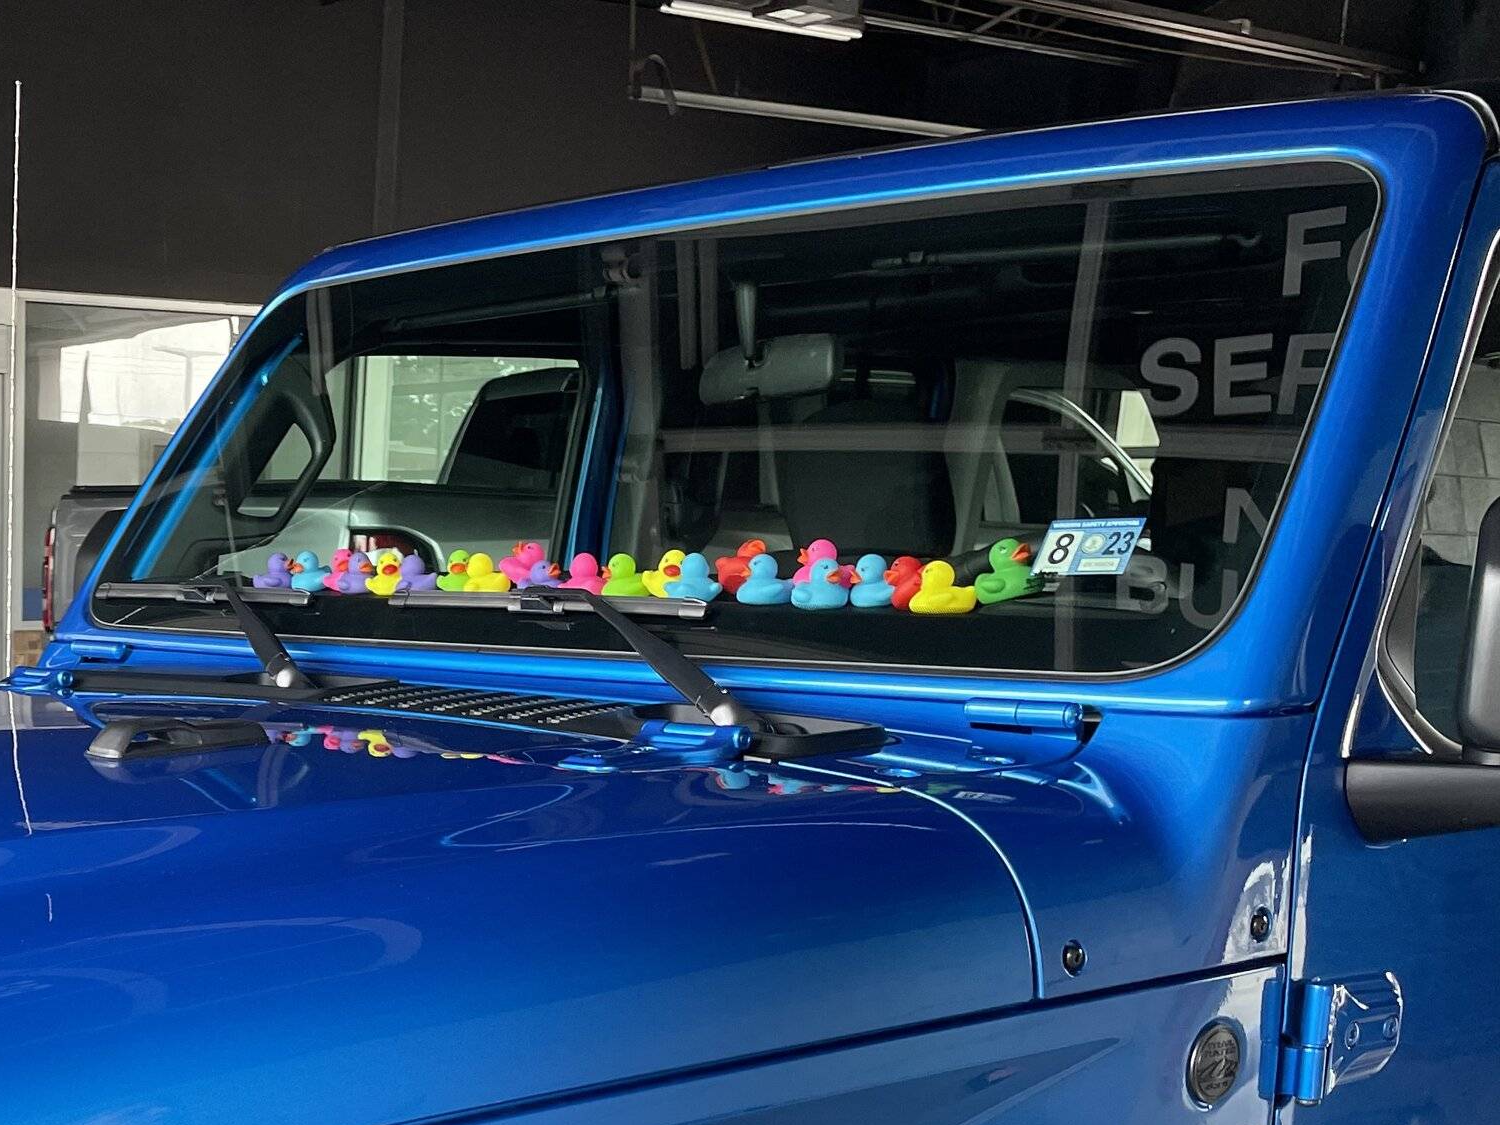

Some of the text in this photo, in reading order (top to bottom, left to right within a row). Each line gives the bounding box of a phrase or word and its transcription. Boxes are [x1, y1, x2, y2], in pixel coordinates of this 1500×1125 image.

[1282, 205, 1370, 297] F
[1048, 532, 1135, 564] 8 23
